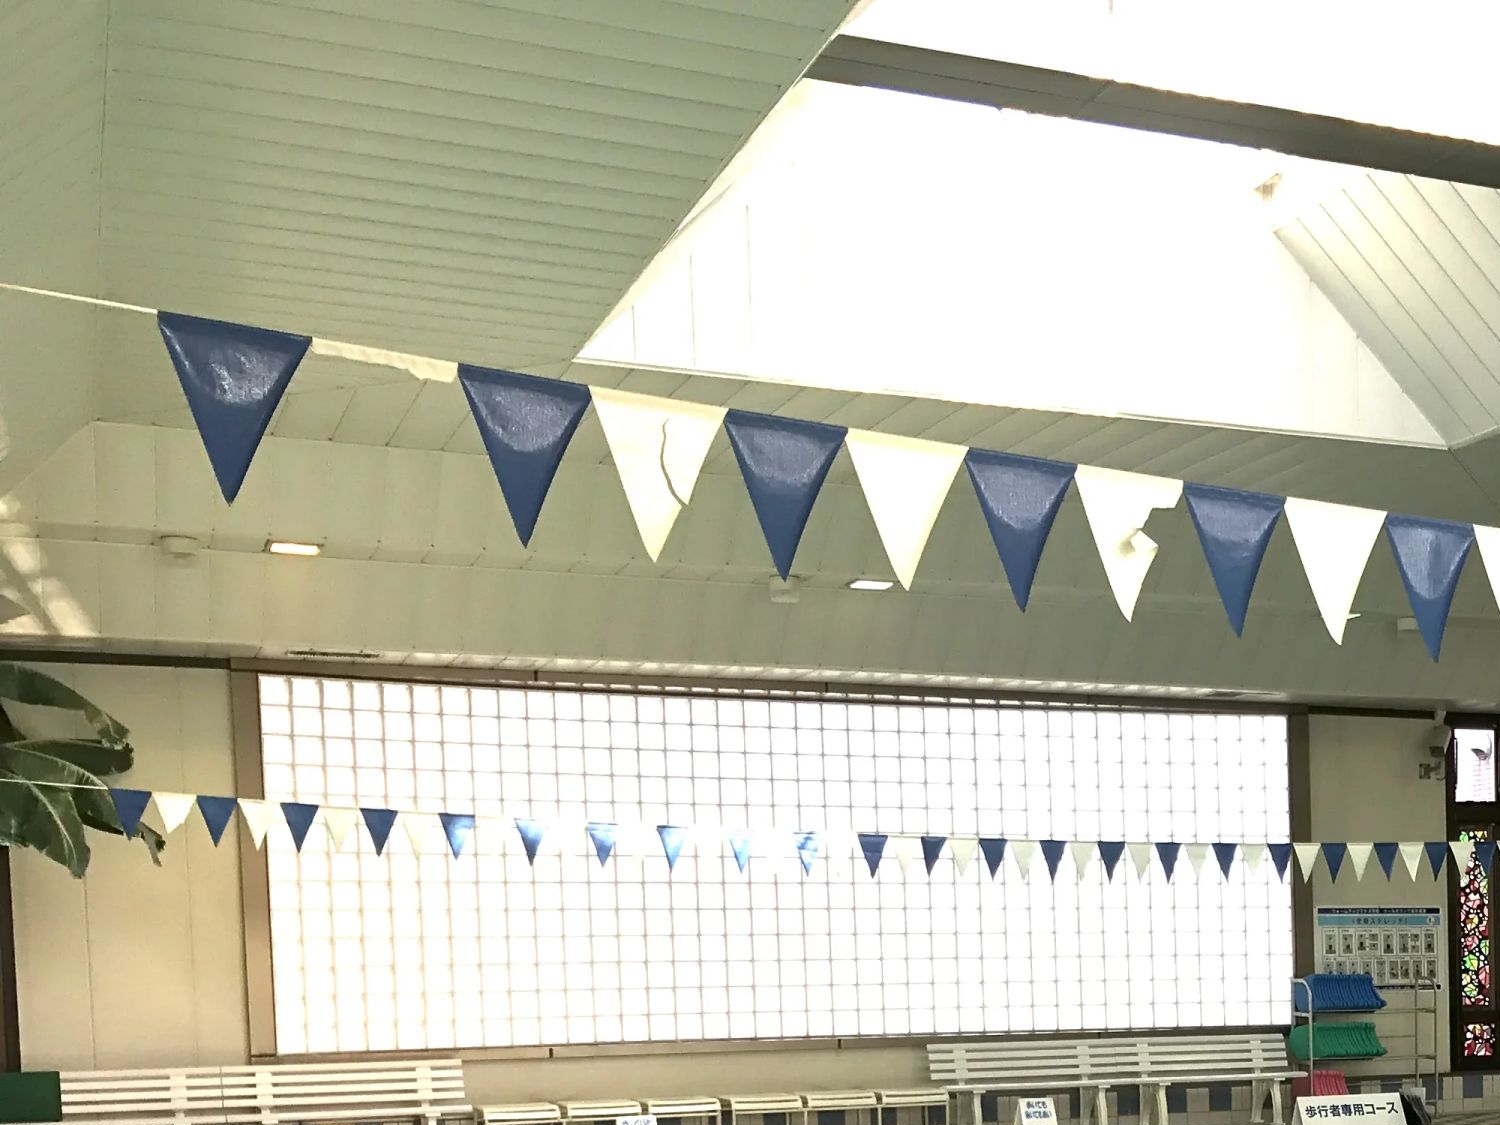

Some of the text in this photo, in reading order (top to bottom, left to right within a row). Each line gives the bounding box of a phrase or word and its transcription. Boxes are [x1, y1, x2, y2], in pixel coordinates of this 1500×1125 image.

[1305, 1102, 1398, 1118] 歩行者専用コース
